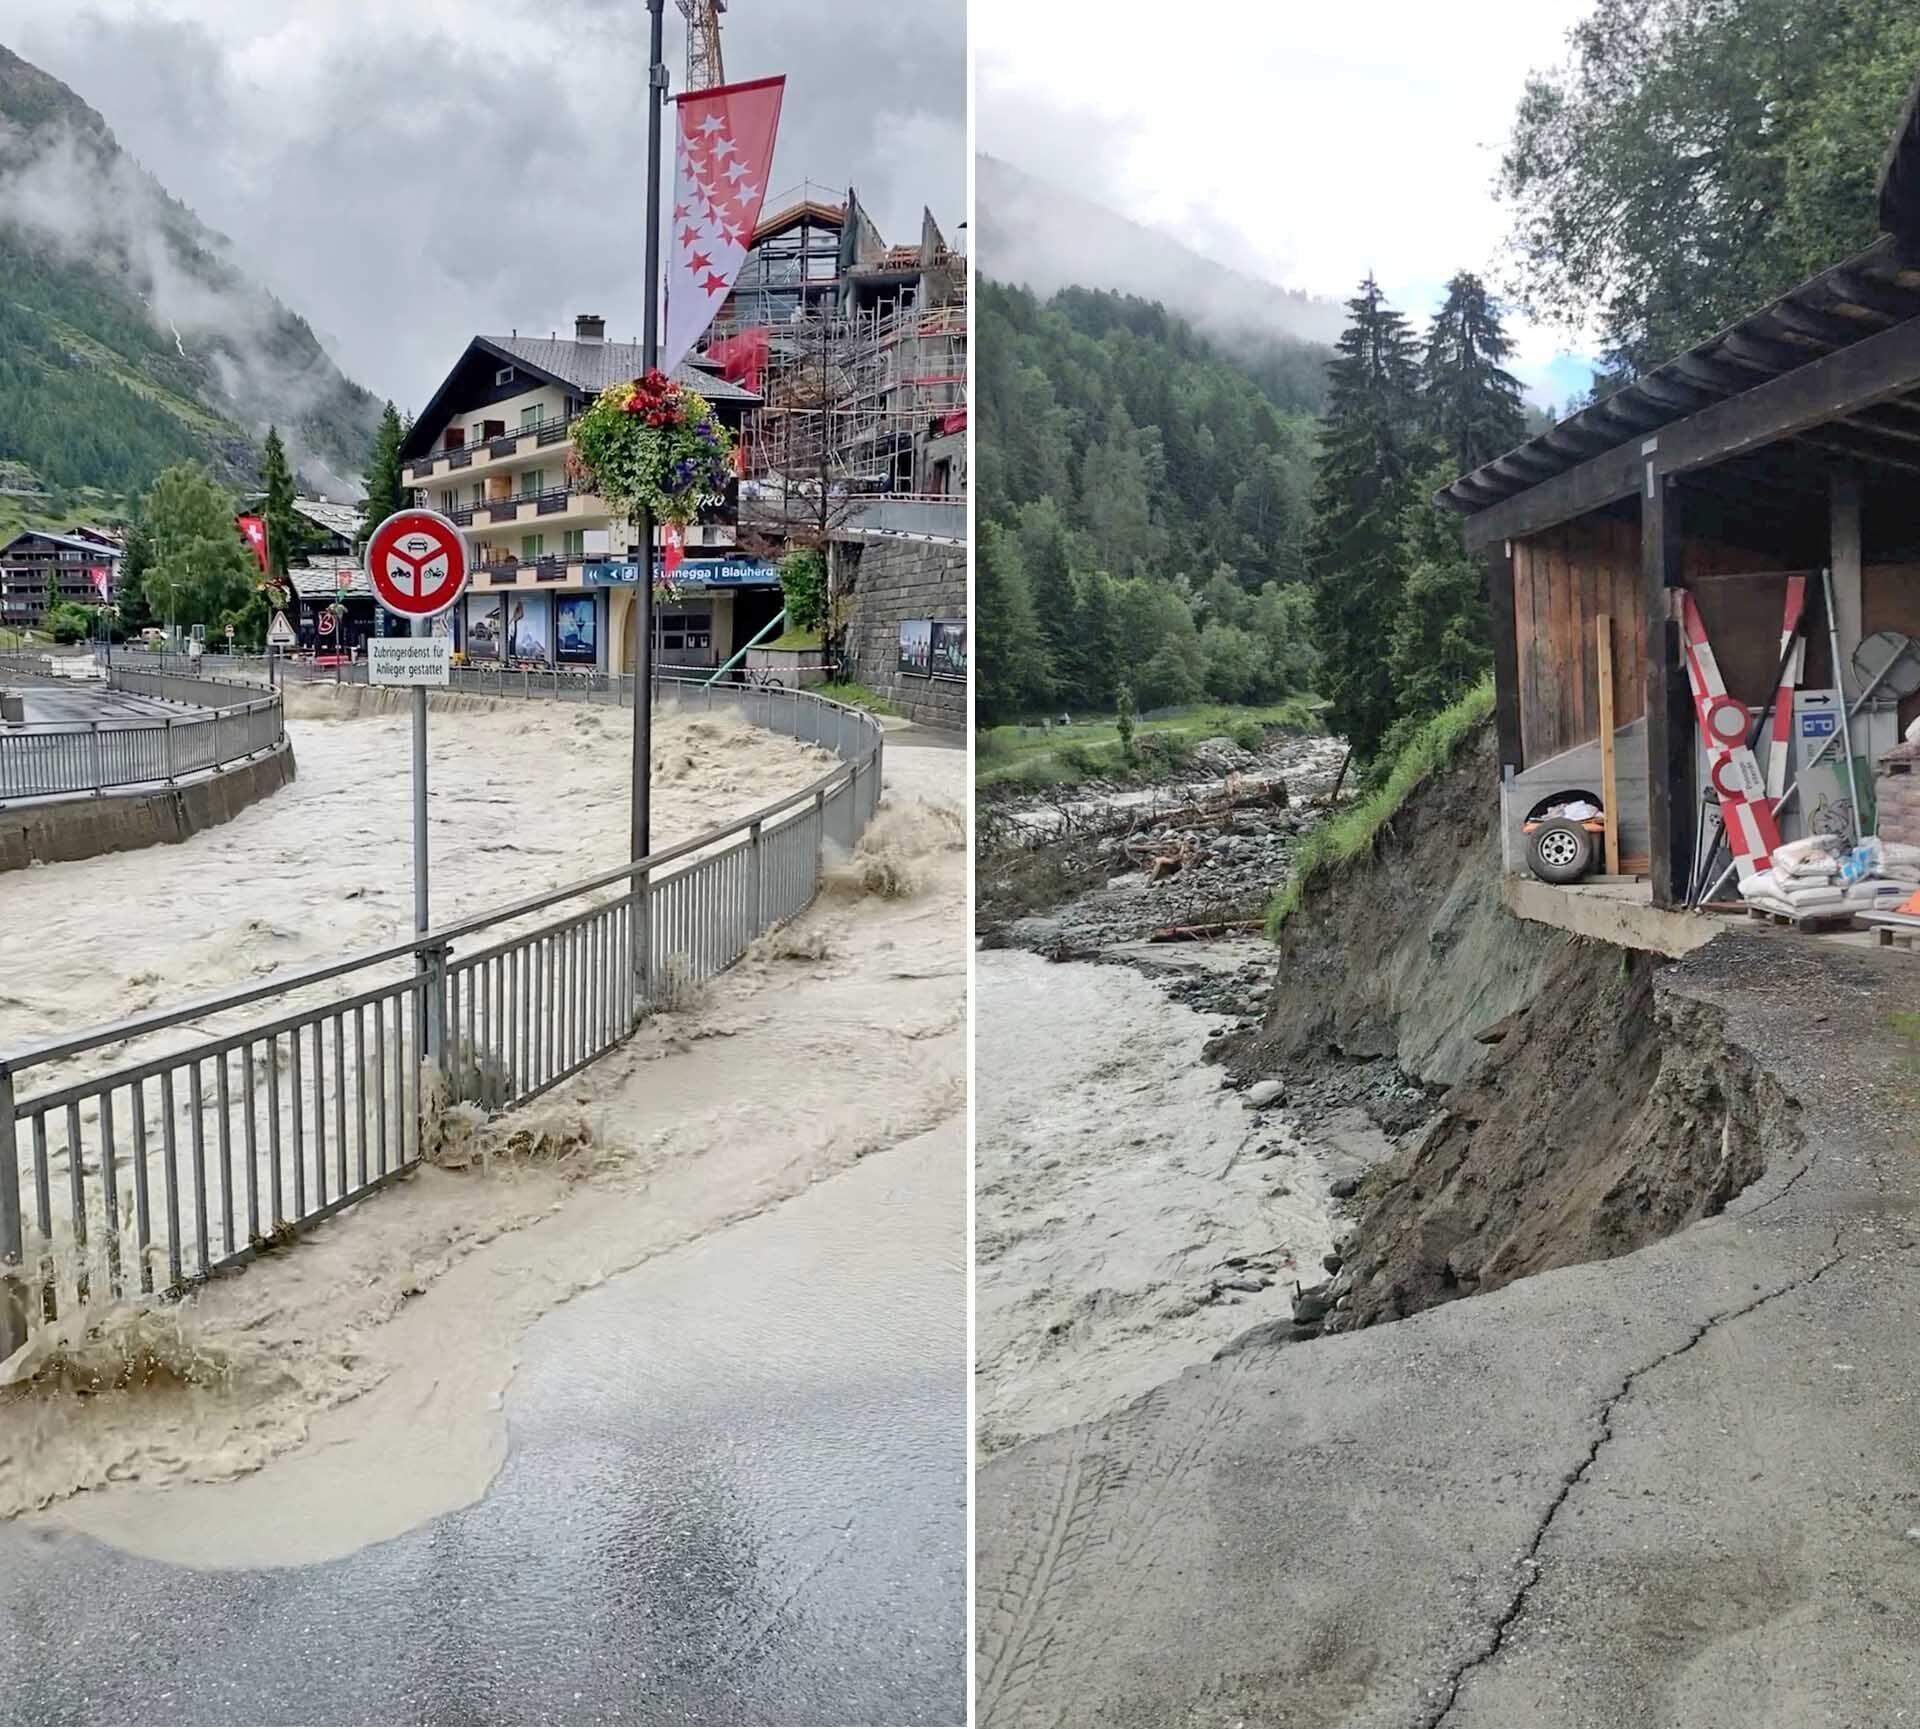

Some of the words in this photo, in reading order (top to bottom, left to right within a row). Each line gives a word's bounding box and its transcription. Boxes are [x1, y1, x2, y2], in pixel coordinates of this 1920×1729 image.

[373, 645, 430, 661] Zubringerdienst
[433, 644, 444, 658] für
[376, 663, 406, 678] Anlieger
[408, 663, 443, 678] gestattet
